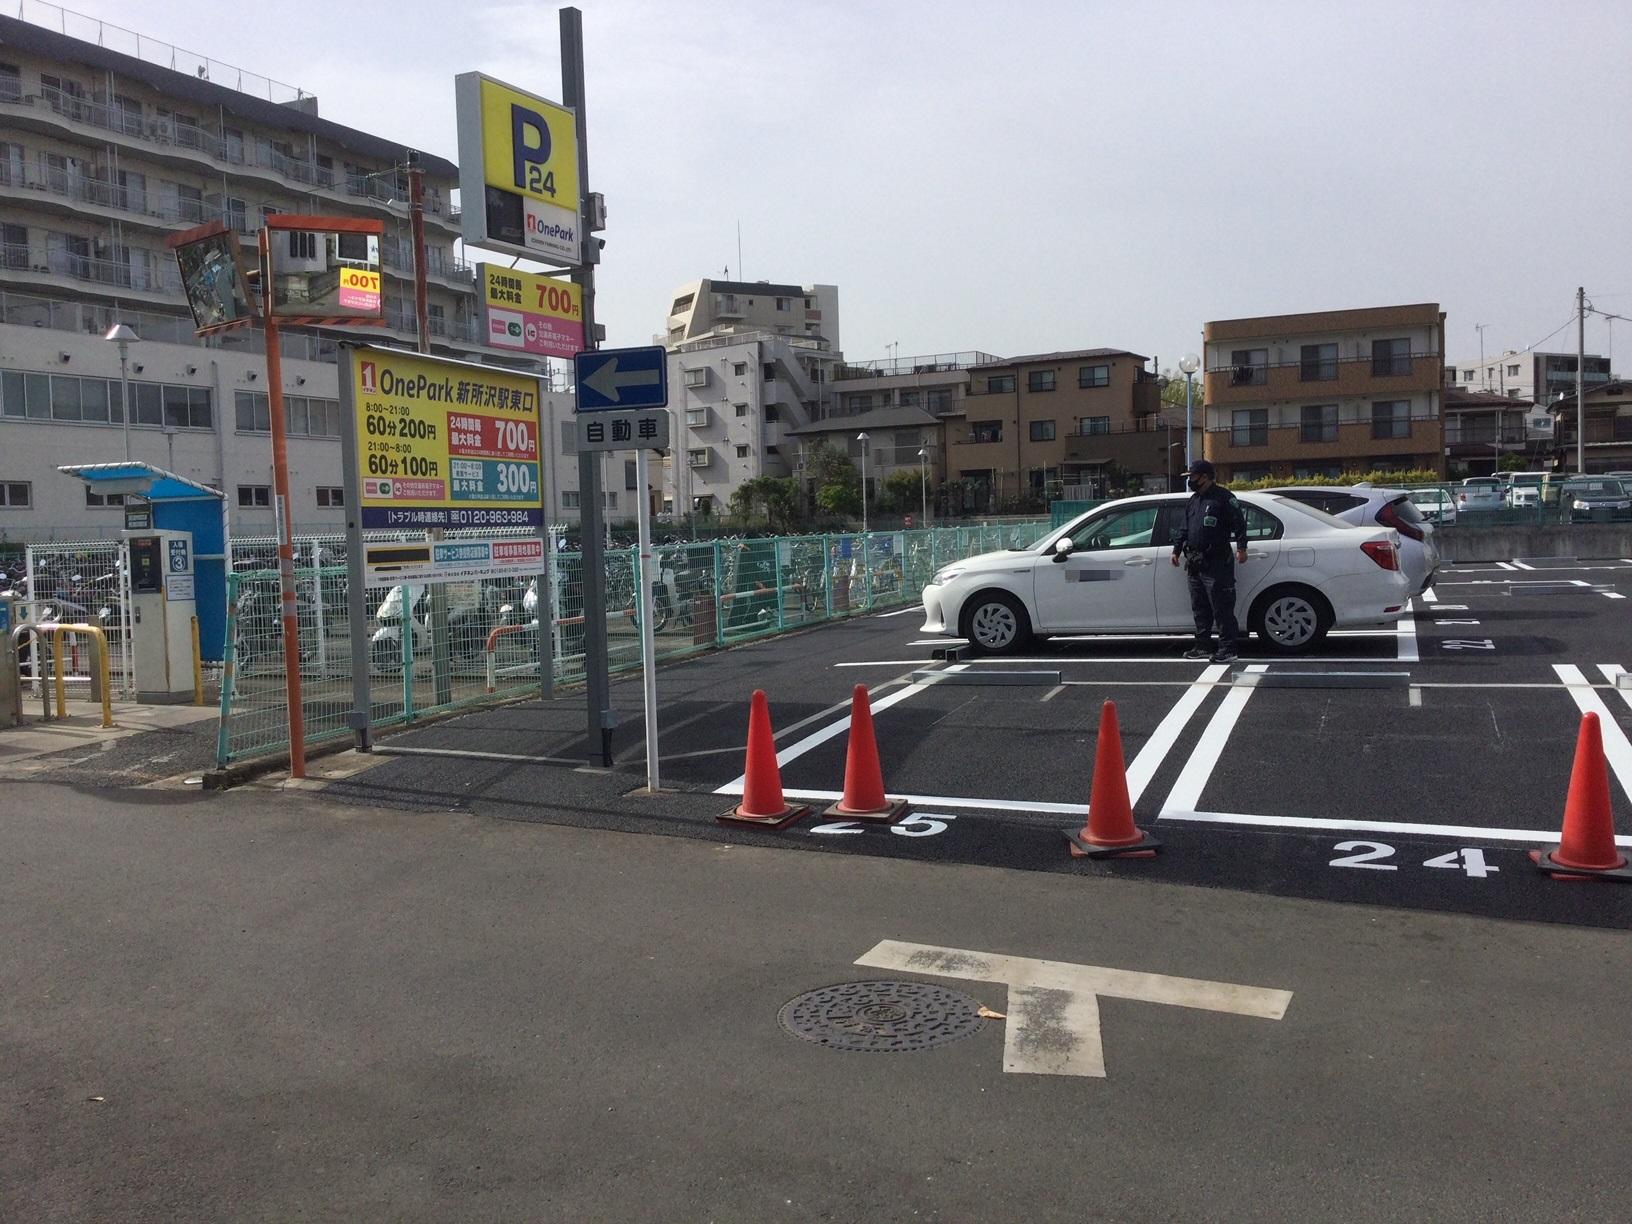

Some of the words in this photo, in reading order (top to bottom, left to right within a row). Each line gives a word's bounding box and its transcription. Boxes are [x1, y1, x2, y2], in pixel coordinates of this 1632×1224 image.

[511, 103, 552, 189] P
[529, 165, 557, 198] 24
[537, 219, 574, 242] OnePark
[490, 287, 522, 304] 最大料金
[536, 284, 579, 316] 700円
[380, 368, 454, 403] OnePark
[456, 380, 534, 412] 新所沢駅東口
[451, 431, 482, 447] 最大料金
[495, 420, 535, 452] 700円
[587, 418, 658, 442] 自動車
[496, 462, 537, 494] 300円
[460, 510, 529, 524] 0120-963-984
[1328, 840, 1500, 878] 24
